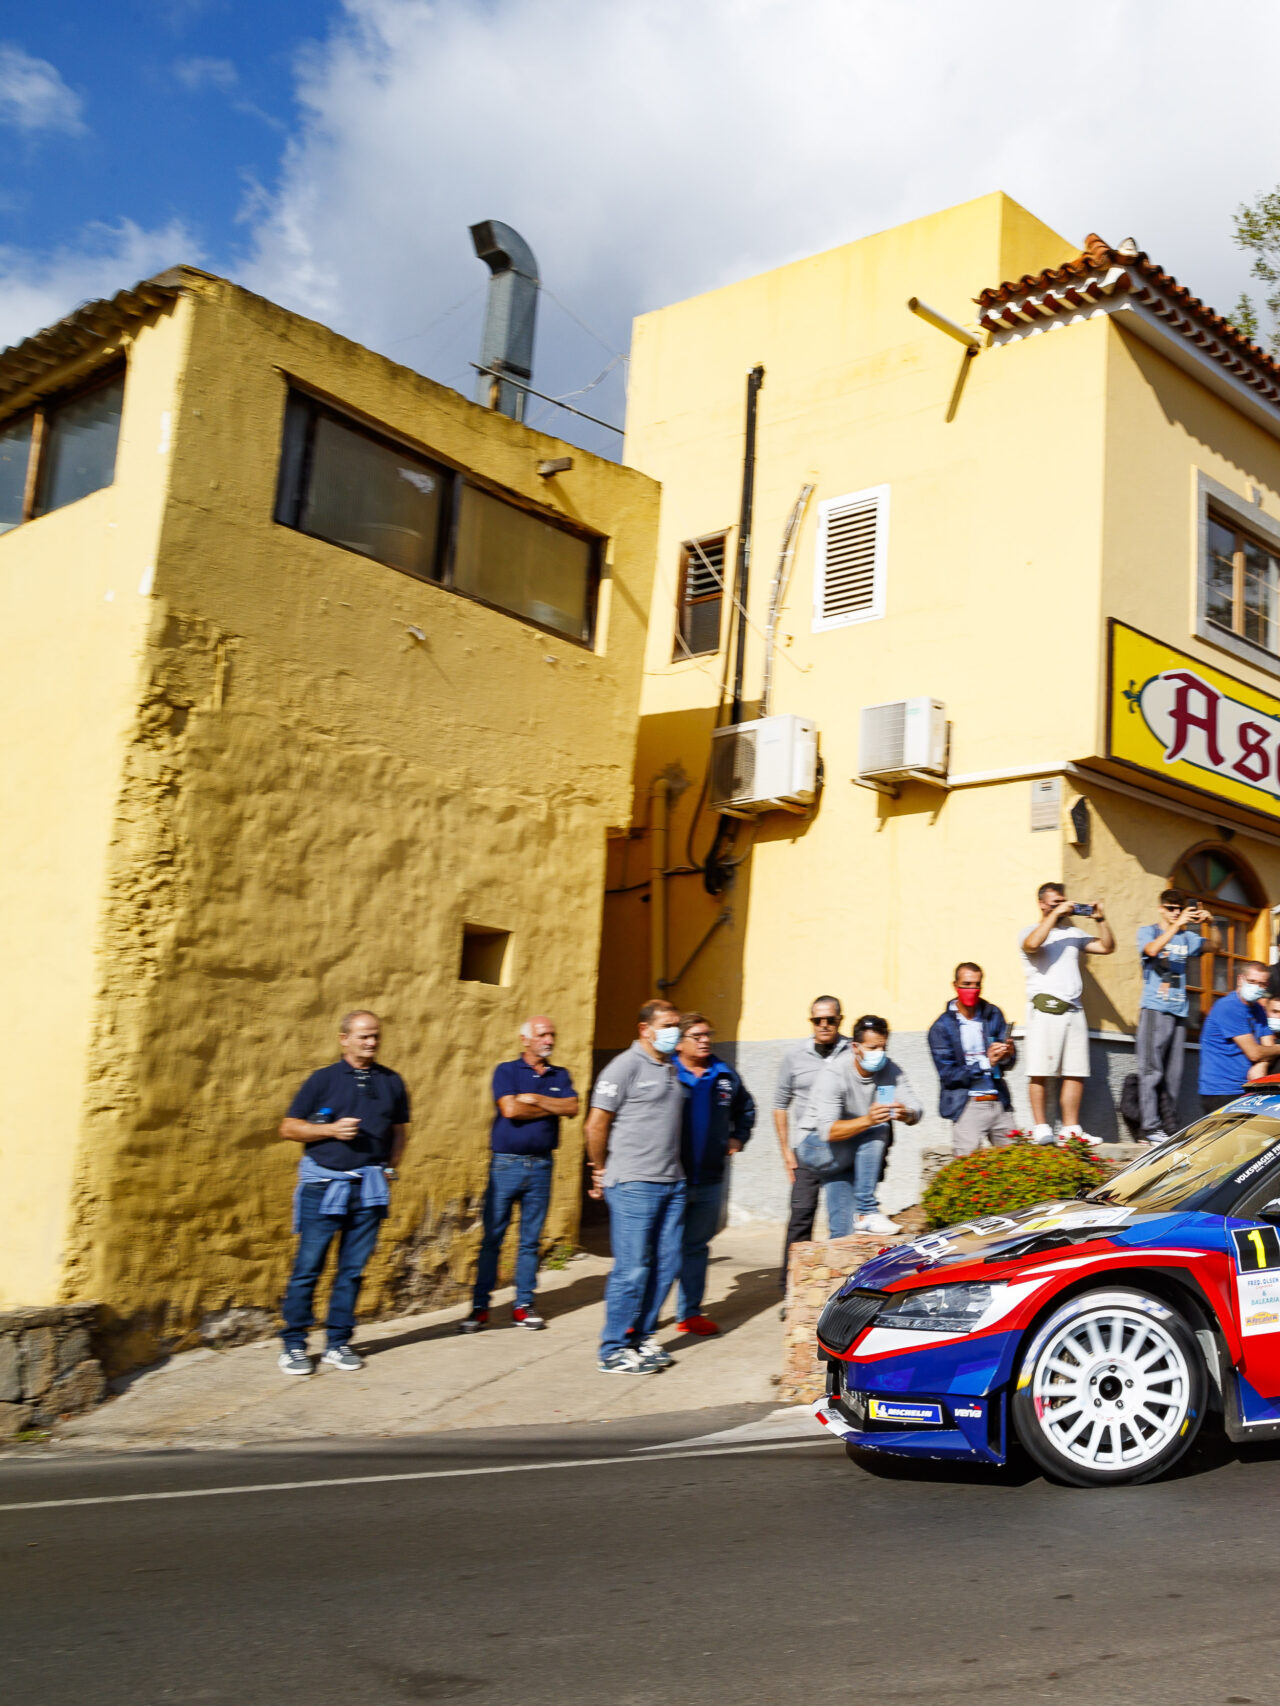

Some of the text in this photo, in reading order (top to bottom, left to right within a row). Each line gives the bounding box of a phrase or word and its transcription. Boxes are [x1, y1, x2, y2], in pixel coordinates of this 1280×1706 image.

[1234, 1150, 1275, 1184] VOLKSWAGEN
[1247, 1229, 1267, 1268] 1
[887, 1407, 933, 1418] MICHELIN
[954, 1408, 983, 1418] verva
